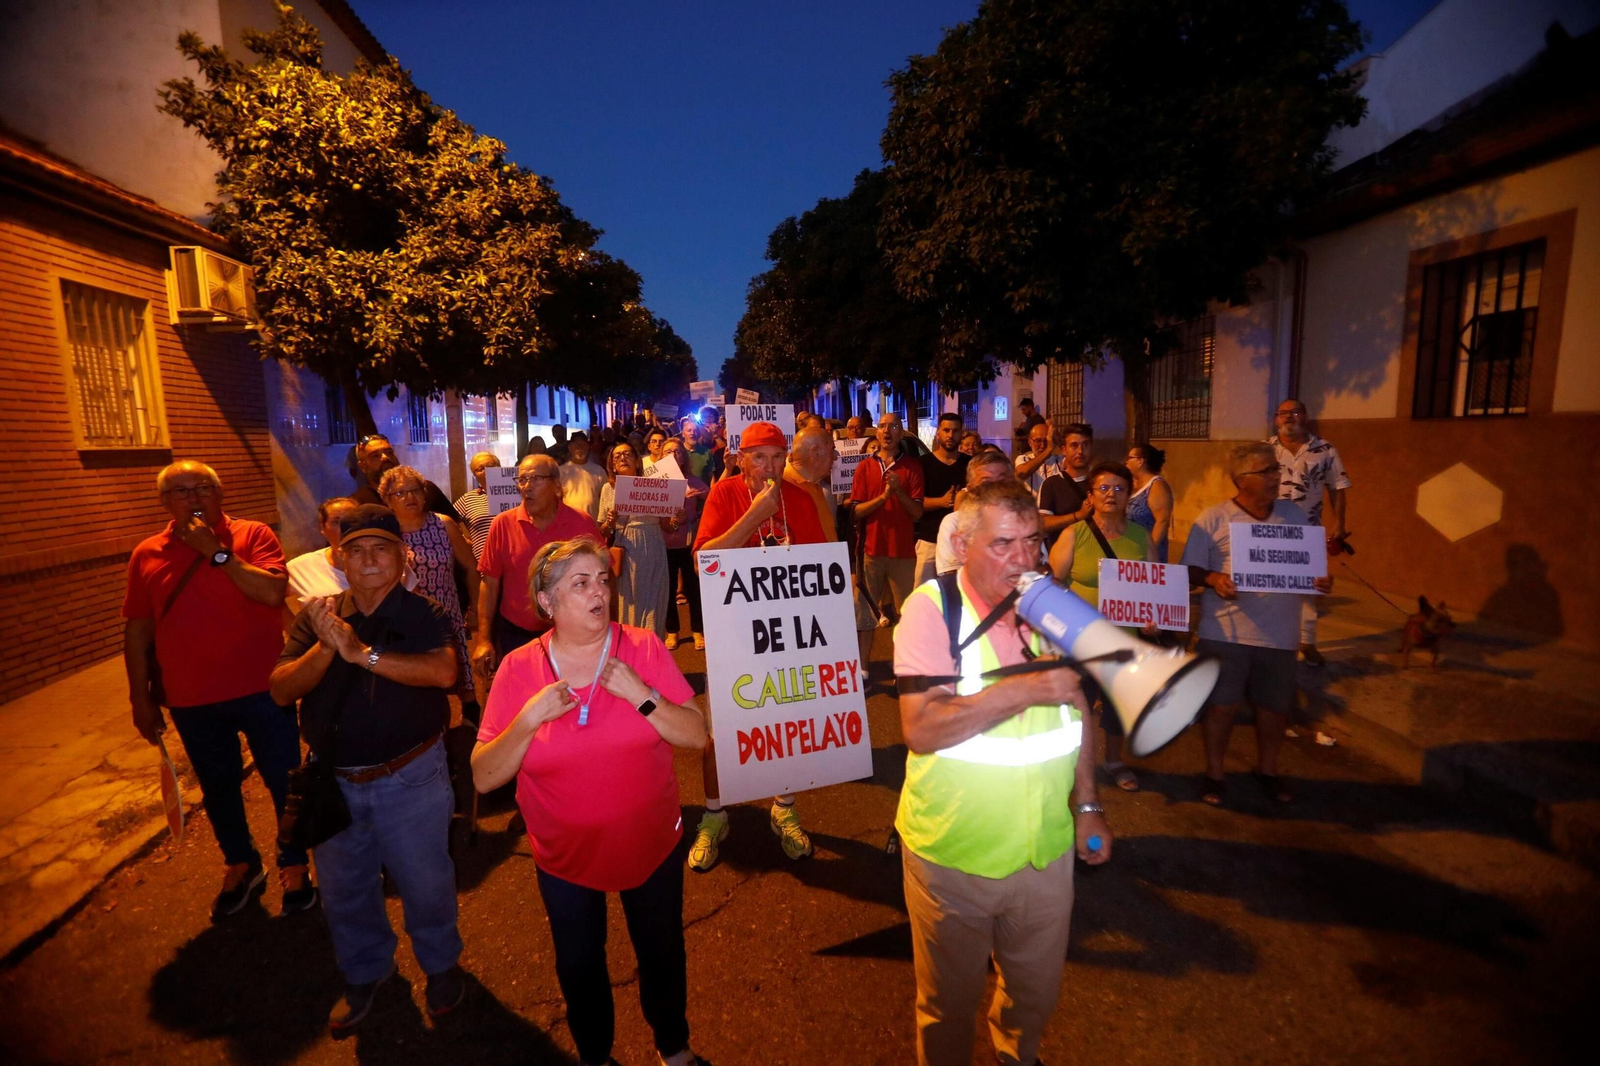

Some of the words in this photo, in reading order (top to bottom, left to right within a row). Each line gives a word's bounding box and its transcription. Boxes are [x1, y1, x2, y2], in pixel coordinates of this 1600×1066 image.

[741, 405, 764, 421] PODA
[766, 405, 777, 421] DE
[633, 477, 668, 488] QUEREMOS
[839, 483, 853, 491] NUEST
[629, 491, 659, 502] MEJORAS
[660, 493, 669, 502] EN
[615, 503, 673, 515] INFRAESTRUCTURAS
[1251, 524, 1304, 540] NECESITAMOS
[1249, 545, 1266, 563] MÁS
[1267, 549, 1311, 565] SEGURIDAD
[1118, 560, 1148, 584] PODA
[1151, 563, 1166, 585] DE
[1233, 572, 1244, 587] EN
[1246, 573, 1287, 589] NUESTRAS
[723, 562, 846, 605] ARREGLO
[1101, 598, 1153, 624] ARBOLES
[752, 617, 785, 654] DE
[793, 614, 828, 649] LA
[731, 665, 817, 709] CALLE
[818, 659, 858, 697] REY
